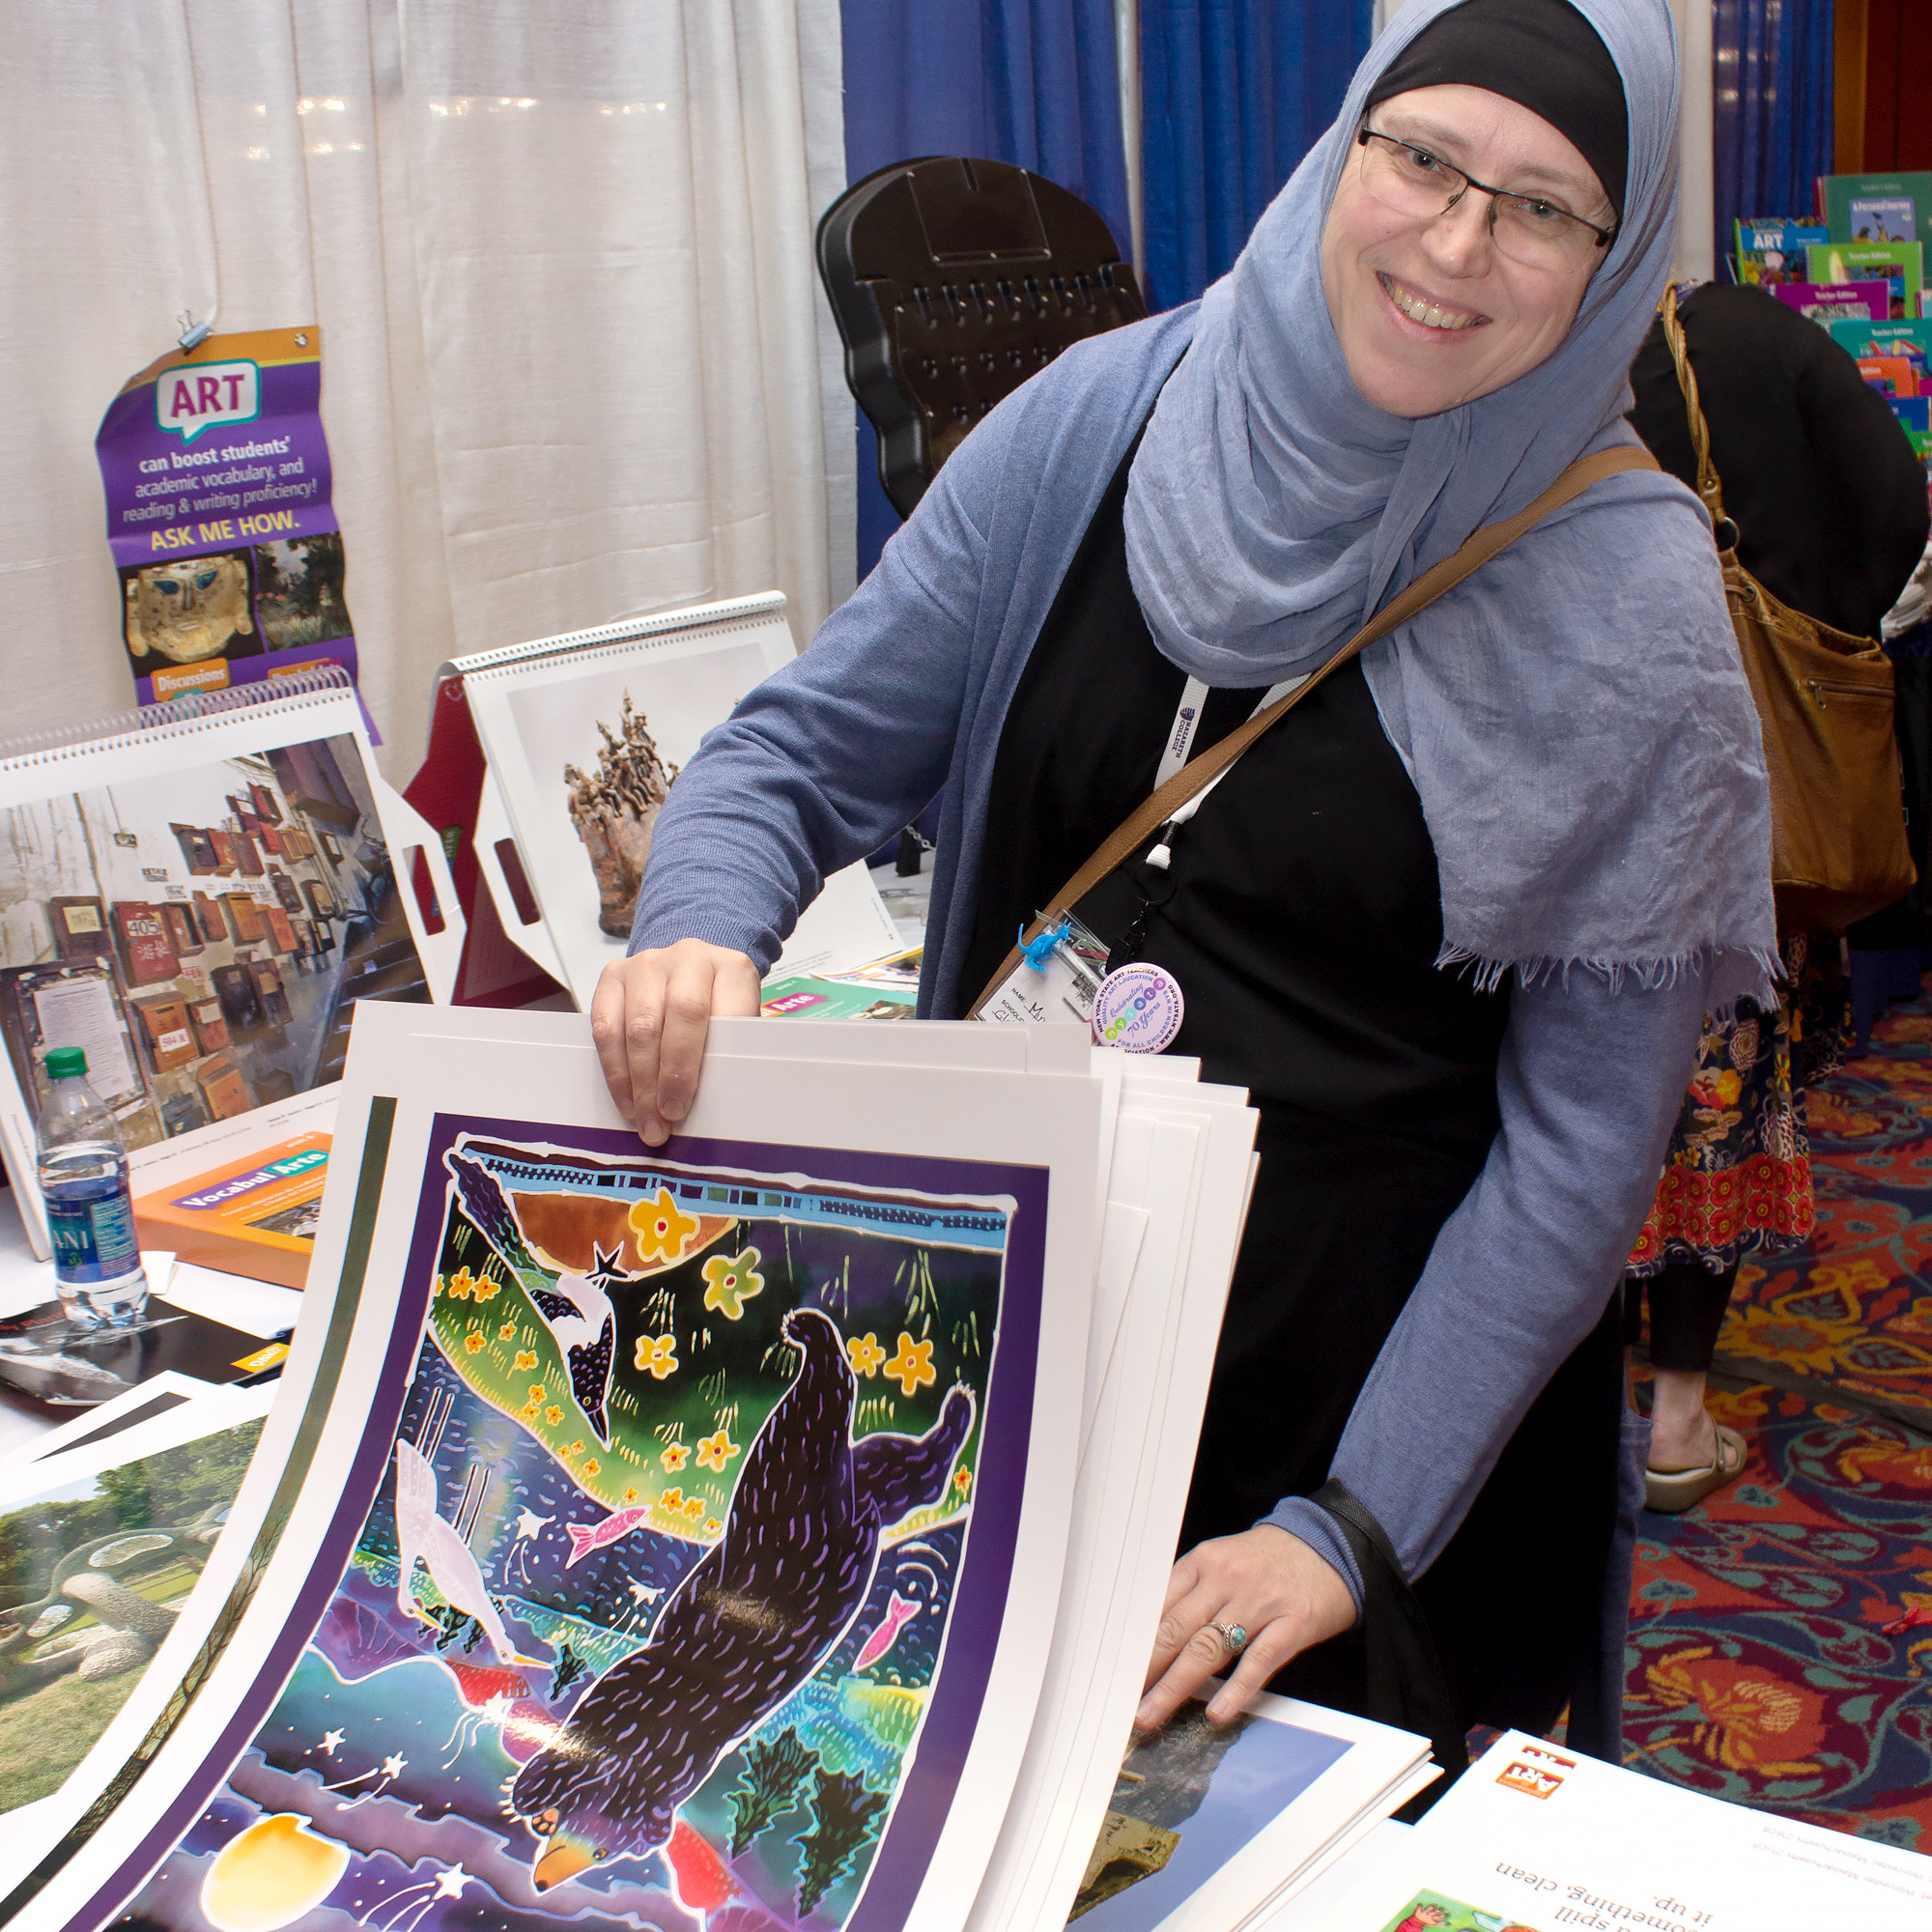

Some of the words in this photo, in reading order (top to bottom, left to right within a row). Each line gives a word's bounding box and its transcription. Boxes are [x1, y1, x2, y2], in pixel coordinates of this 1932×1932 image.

[1753, 233, 1783, 249] ART
[170, 374, 245, 418] ART
[139, 458, 169, 473] can
[170, 447, 219, 469] boost
[220, 436, 291, 462] students'
[135, 473, 200, 498] academic
[201, 464, 276, 488] vocabulary,
[278, 456, 304, 476] and
[123, 501, 176, 523] reading
[178, 497, 191, 515] &
[192, 491, 242, 512] writing
[242, 477, 318, 508] proficiency!
[151, 526, 196, 552] ASK
[198, 520, 235, 543] ME
[238, 509, 300, 536] HOW.
[157, 668, 226, 692] Discussions
[1172, 720, 1185, 752] COLLEGE
[1176, 722, 1191, 758] NAZARETH
[128, 921, 159, 935] 405
[1100, 979, 1114, 998] STATE
[1114, 972, 1125, 980] ART
[1126, 968, 1159, 977] TEACHERS
[1108, 984, 1120, 996] ART
[1119, 975, 1154, 985] EDUCATION
[771, 995, 814, 1010] Arte
[1110, 982, 1144, 1018] Celebrating
[1167, 1006, 1172, 1014] IN
[1126, 1021, 1140, 1038] 70
[1139, 1002, 1161, 1030] Years
[1147, 1015, 1171, 1045] CHILDREN
[1118, 1038, 1131, 1048] FOR
[182, 1172, 277, 1208] Vocabul
[271, 1152, 327, 1175] Arte
[1505, 1766, 1560, 1793] ART
[1495, 1861, 1558, 1891] clean
[1554, 1906, 1610, 1931] spill
[1567, 1885, 1698, 1932] omething,
[1653, 1896, 1687, 1917] up.
[1692, 1910, 1714, 1928] it
